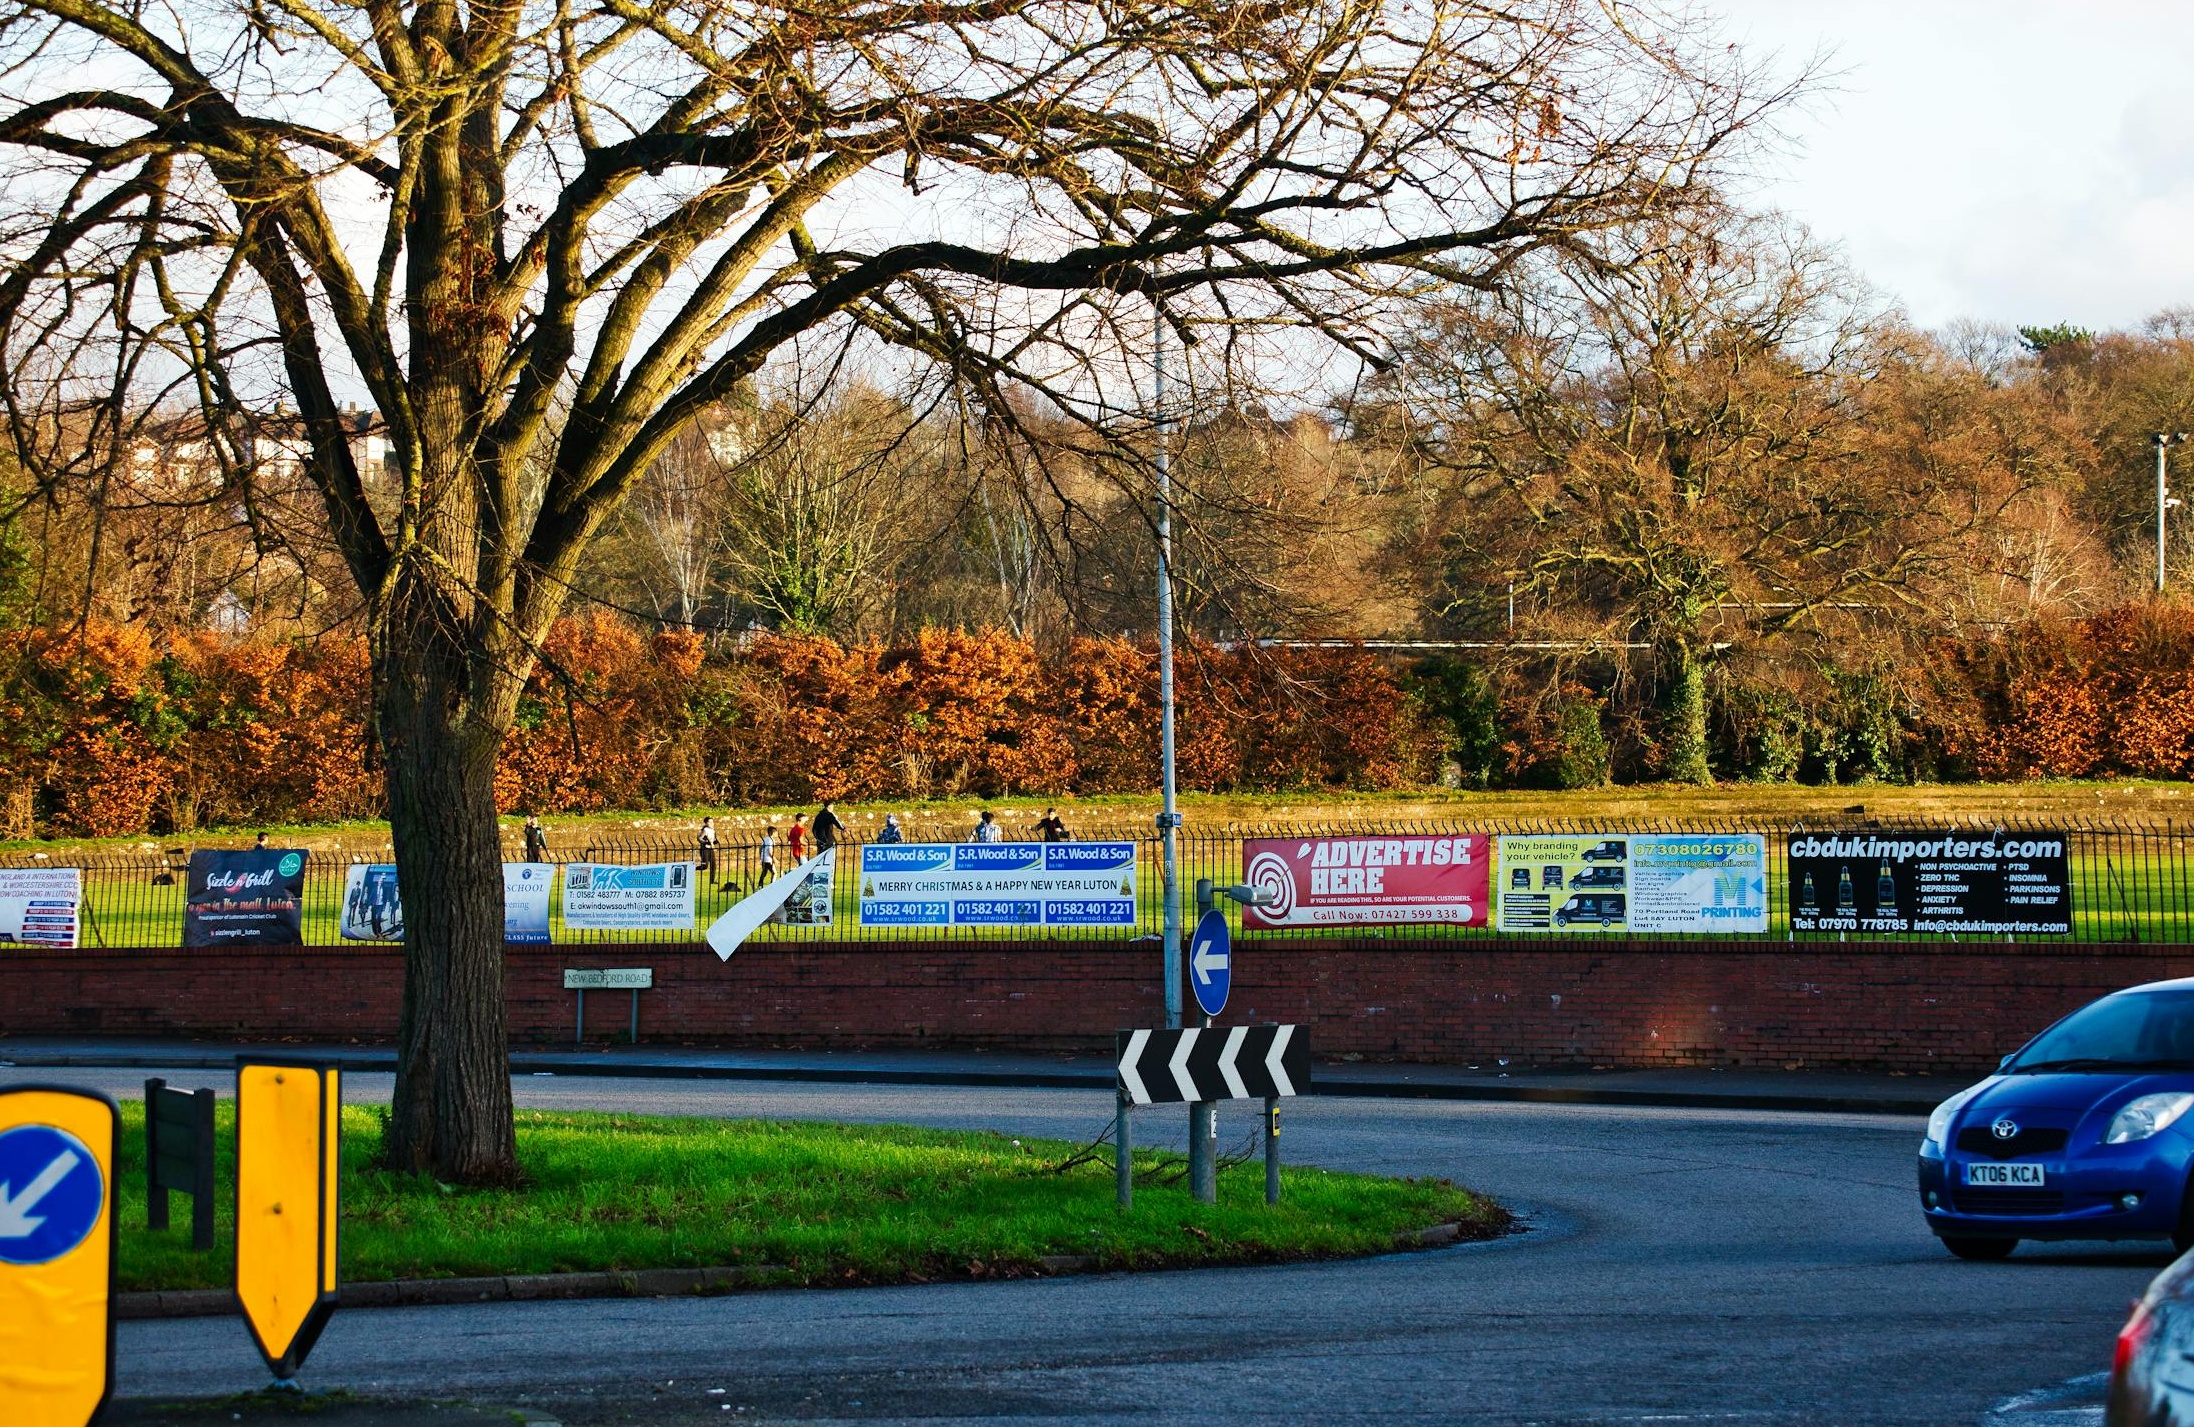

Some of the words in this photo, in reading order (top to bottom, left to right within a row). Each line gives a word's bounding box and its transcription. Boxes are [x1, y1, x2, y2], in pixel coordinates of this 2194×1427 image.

[1507, 842, 1529, 851] Why
[1533, 842, 1578, 851] branding
[1634, 843, 1758, 855] 07308026780
[1790, 836, 2062, 863] cbdukimporters.com
[867, 850, 886, 861] S.R.
[886, 850, 915, 861] Wood
[917, 850, 926, 861] &
[927, 850, 947, 861] Son
[958, 848, 977, 859] S.R.
[978, 848, 1007, 859] Wood
[1008, 848, 1017, 859] &
[1018, 848, 1038, 859] Son
[1048, 848, 1068, 859] S.R.
[1068, 848, 1098, 859] Wood
[1099, 848, 1109, 859] &
[1110, 848, 1130, 859] Son
[1311, 838, 1471, 868] ADVERTISE
[1507, 853, 1529, 861] your
[1533, 852, 1576, 860] vehicle?
[1920, 863, 1937, 871] NON
[1939, 863, 1997, 871] PSYCHOACTIVE
[2008, 863, 2029, 871] PTSD
[207, 870, 234, 890] Sizzle
[245, 869, 274, 888] Grill
[1311, 867, 1384, 895] HERE
[2008, 874, 2047, 882] INSOMNIA
[506, 884, 544, 892] SCHOOL
[879, 881, 912, 891] MERRY
[915, 881, 973, 891] CHRISTMAS
[975, 881, 983, 891] &
[985, 881, 992, 890] A
[995, 880, 1028, 890] HAPPY
[1031, 880, 1053, 890] NEW
[1055, 880, 1080, 890] YEAR
[1083, 880, 1117, 890] LUTON
[2009, 885, 2061, 893] PARKINSONS
[659, 890, 686, 898] 895737
[2010, 896, 2029, 904] PAIN
[2030, 896, 2058, 904] RELIEF
[865, 903, 900, 915] 01582
[902, 903, 922, 915] 401
[925, 903, 946, 915] 221
[957, 903, 992, 915] 01582
[994, 903, 1014, 914] 401
[1048, 903, 1084, 915] 01582
[1086, 903, 1106, 914] 401
[1109, 903, 1130, 914] 221
[1314, 910, 1335, 920] Call
[1339, 910, 1368, 920] Now:
[1371, 910, 1406, 920] 07427
[1411, 910, 1432, 919] 599
[1437, 909, 1458, 919] 338
[1701, 906, 1763, 918] PRINTING
[1922, 906, 1964, 914] ARTHRITIS
[1793, 918, 1815, 929] Tel:
[1819, 918, 1857, 930] 07970
[1860, 918, 1908, 930] 778785
[1913, 919, 2068, 933] info@cbdukimporters.com
[568, 974, 586, 983] NEW
[589, 974, 623, 983] BEDFORD
[626, 974, 648, 982] ROAD
[1969, 1165, 2007, 1182] KT06
[2011, 1166, 2040, 1182] KCA
